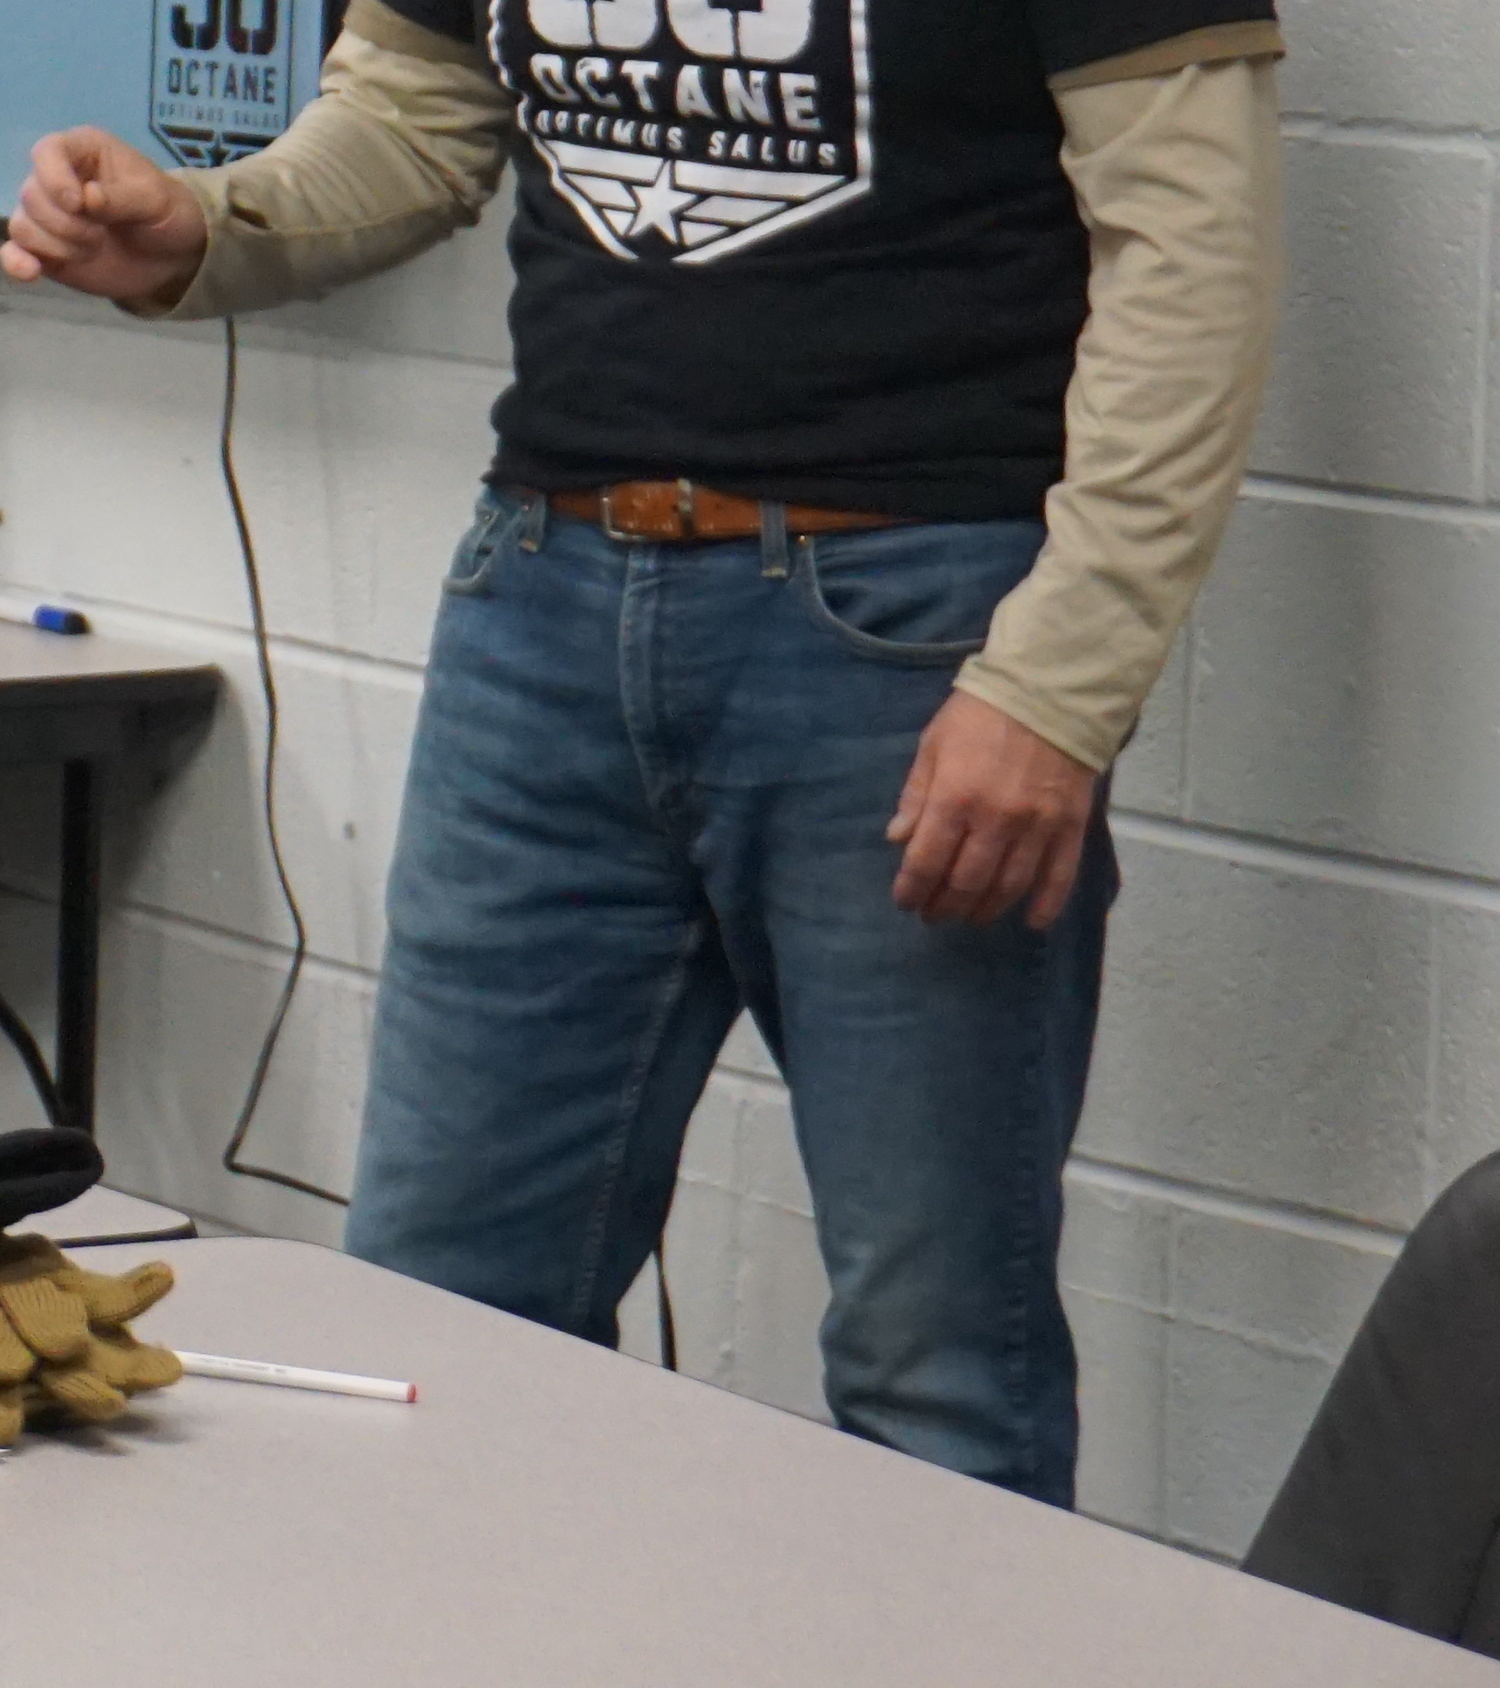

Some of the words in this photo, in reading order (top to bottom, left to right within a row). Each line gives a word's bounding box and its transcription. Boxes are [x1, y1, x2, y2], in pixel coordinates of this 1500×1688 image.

[168, 57, 277, 104] OCTANE
[530, 53, 823, 132] OCTANE
[708, 130, 838, 168] SALUS
